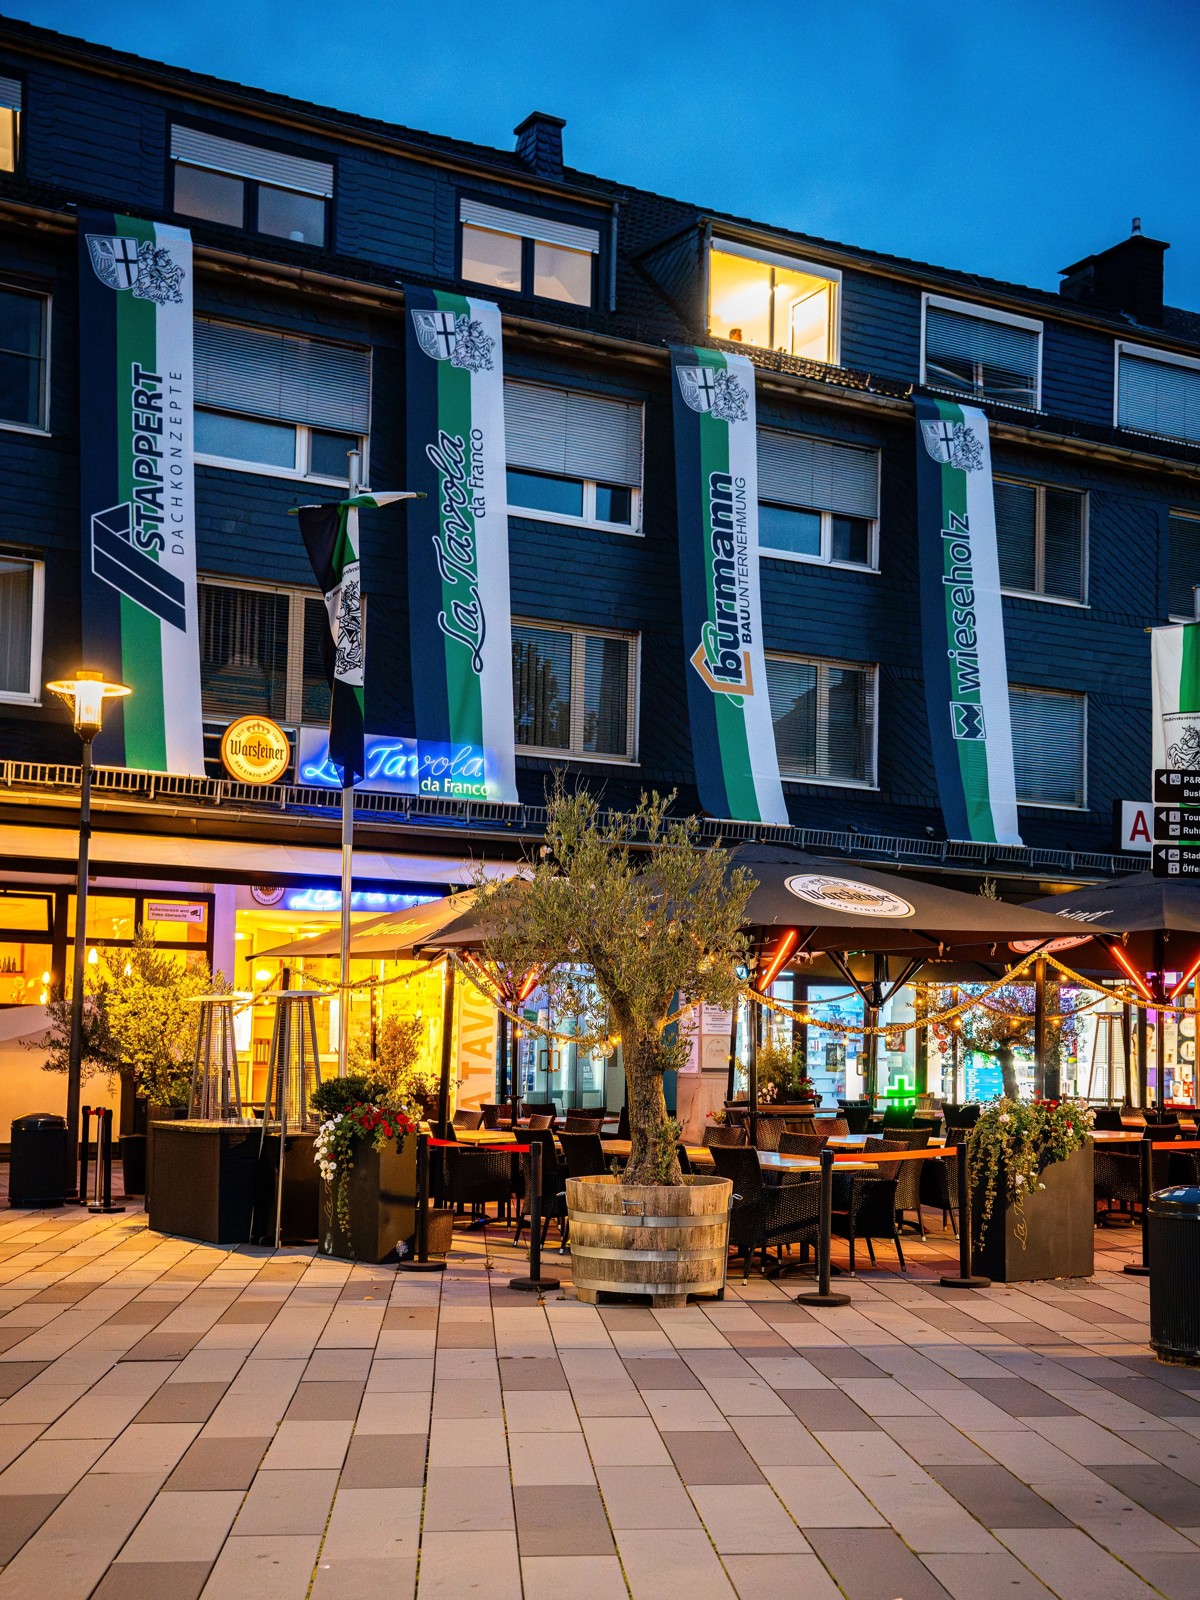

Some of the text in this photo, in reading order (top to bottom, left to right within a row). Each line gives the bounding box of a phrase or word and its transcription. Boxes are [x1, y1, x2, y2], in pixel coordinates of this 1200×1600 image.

[131, 362, 165, 552] STAPPERT
[169, 372, 185, 555] DACHKONZEPTE
[468, 428, 486, 518] da Franco
[426, 430, 486, 674] La Tavola
[709, 471, 743, 680] burmann
[735, 477, 752, 644] BAUUNTERNEHMUNG
[941, 510, 981, 694] wieseholz
[230, 739, 284, 761] Warsteiner
[368, 745, 484, 778] Tavola
[421, 778, 490, 796] da Franco
[1184, 776, 1200, 784] P&R
[1184, 789, 1200, 797] Bus
[1182, 863, 1200, 873] Öffe
[1183, 826, 1200, 835] Ruh
[462, 985, 495, 1080] TAVO
